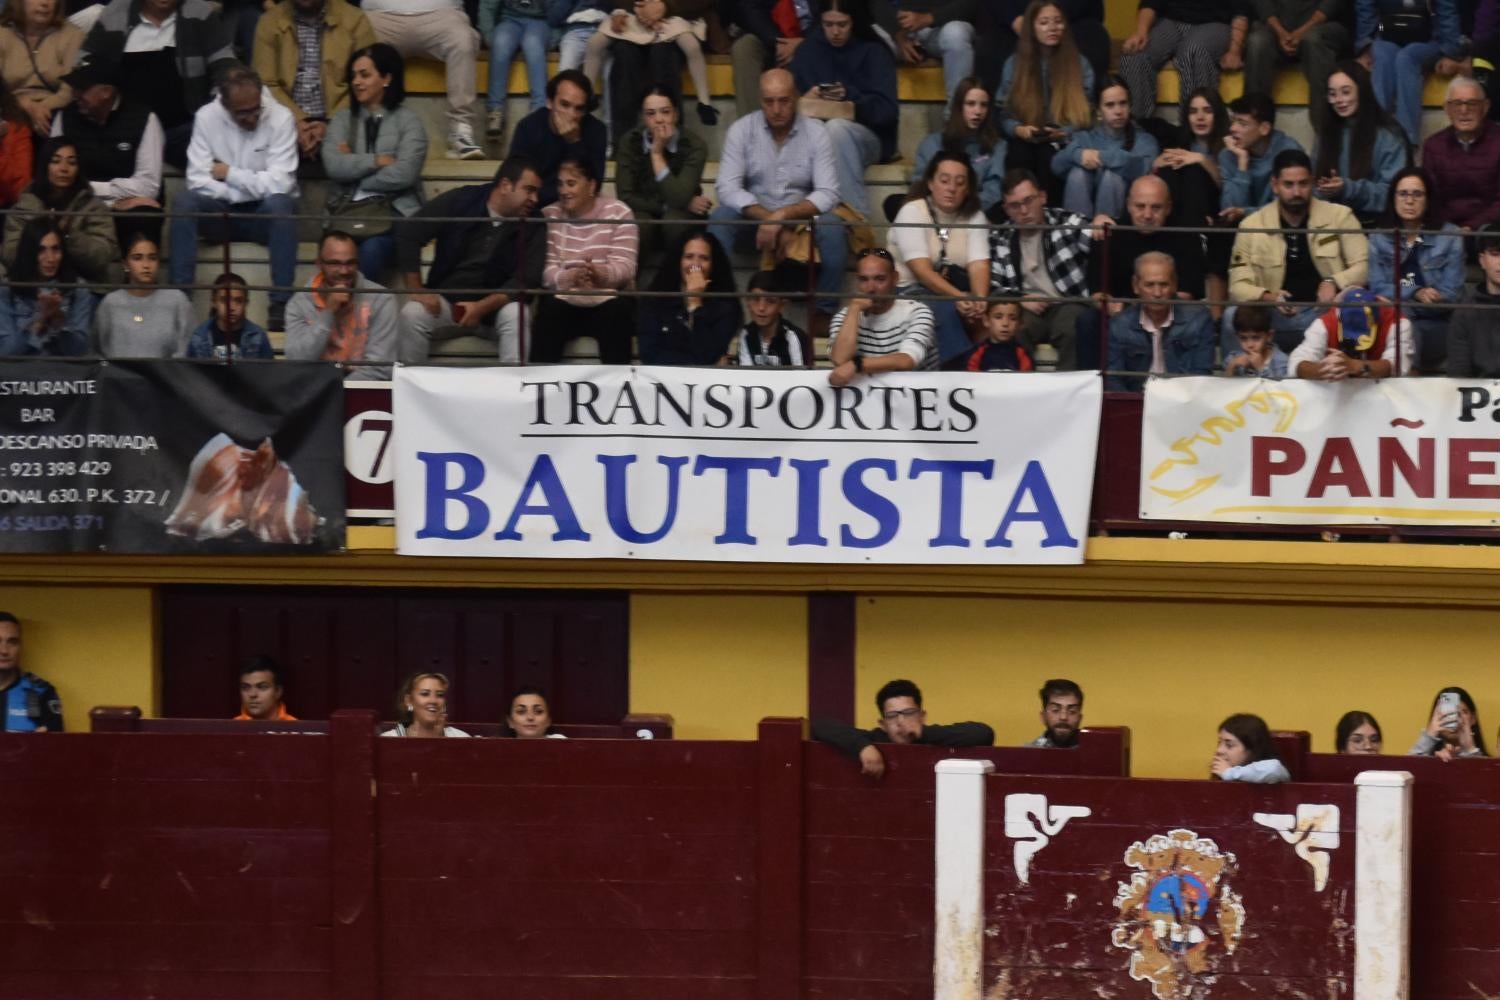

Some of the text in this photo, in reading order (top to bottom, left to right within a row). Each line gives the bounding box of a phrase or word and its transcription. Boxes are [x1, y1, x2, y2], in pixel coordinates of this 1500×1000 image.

[0, 380, 97, 396] STAURANTE
[520, 379, 978, 432] TRANSPORTES
[20, 407, 56, 423] BAR
[87, 434, 158, 451] PRIVADA
[358, 419, 392, 478] 7
[10, 462, 44, 477] 923
[47, 462, 77, 477] 398
[79, 461, 112, 476] 429
[0, 489, 47, 504] ONAL
[123, 489, 156, 504] 372
[416, 452, 1079, 549] BAUTISTA
